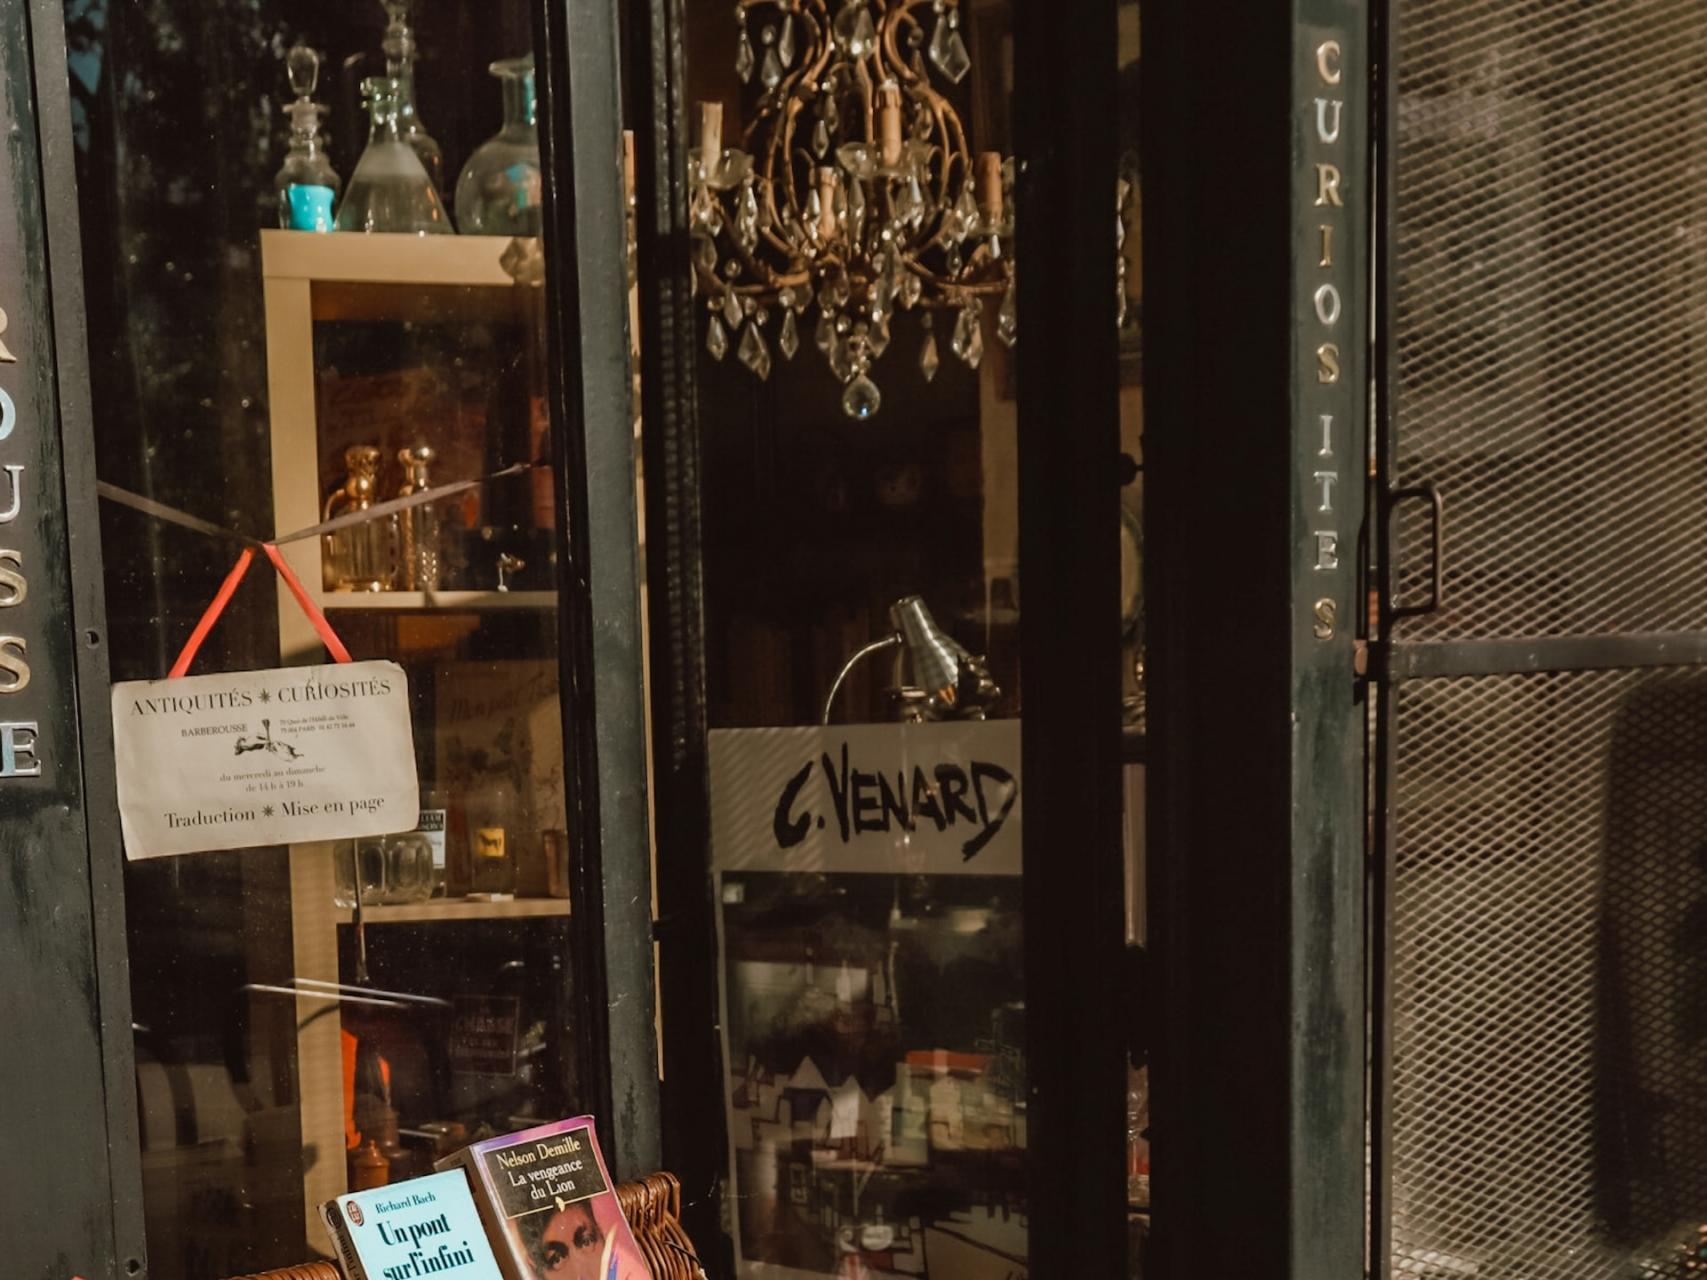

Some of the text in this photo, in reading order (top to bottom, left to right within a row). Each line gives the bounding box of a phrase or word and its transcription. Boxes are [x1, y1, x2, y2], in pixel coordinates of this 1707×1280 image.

[1313, 41, 1343, 640] CURIOSITES
[131, 677, 392, 716] ANTIQUITÉS CURIOSITÉS
[181, 722, 248, 738] BARBEROUSSE
[163, 796, 386, 830] Traduction Mise en page
[497, 1138, 581, 1170] Nelson Demille
[507, 1158, 584, 1188] La vengeance
[375, 1196, 411, 1215] Richard
[412, 1191, 437, 1205] Bach
[530, 1178, 576, 1201] du Lion
[376, 1213, 451, 1249] Un pont
